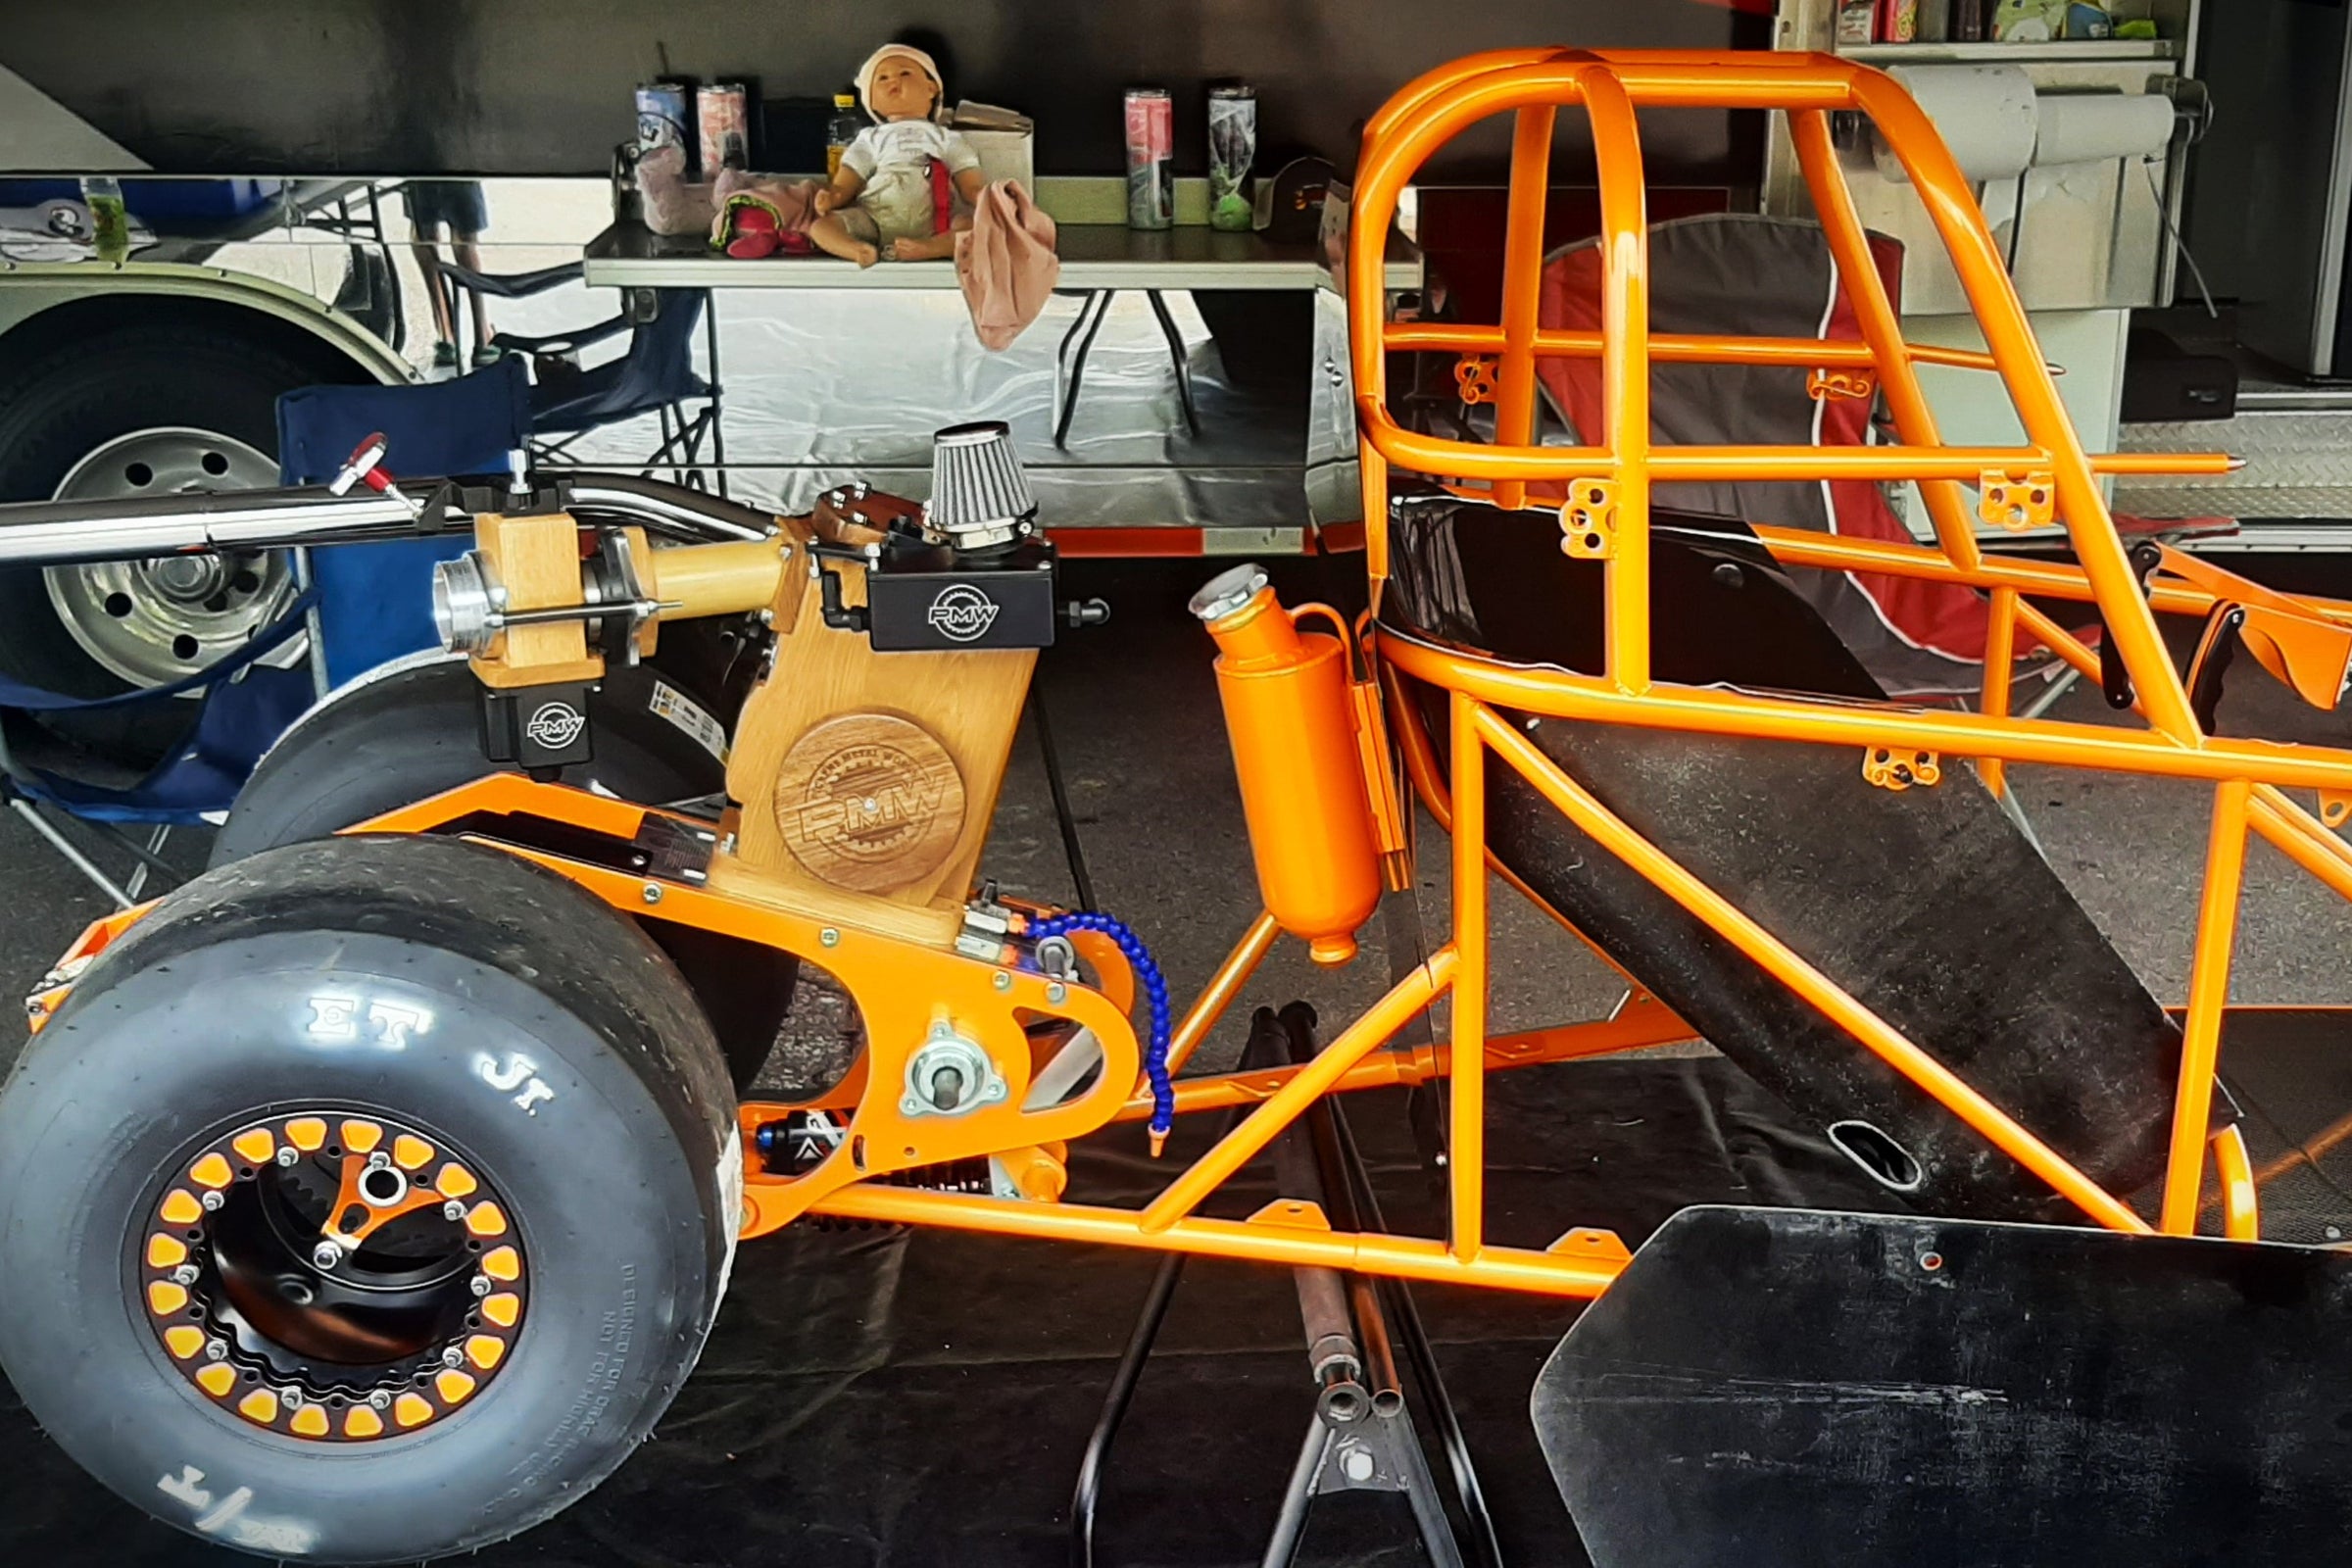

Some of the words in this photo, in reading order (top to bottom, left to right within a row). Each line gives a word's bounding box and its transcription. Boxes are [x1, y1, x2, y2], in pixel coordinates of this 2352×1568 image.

[928, 603, 1000, 625] PMW
[526, 715, 586, 738] PMW
[799, 774, 945, 843] PMW
[305, 995, 431, 1050] ET
[599, 1310, 617, 1343] NOT
[588, 1351, 611, 1385] FOR
[601, 1357, 625, 1392] FOR
